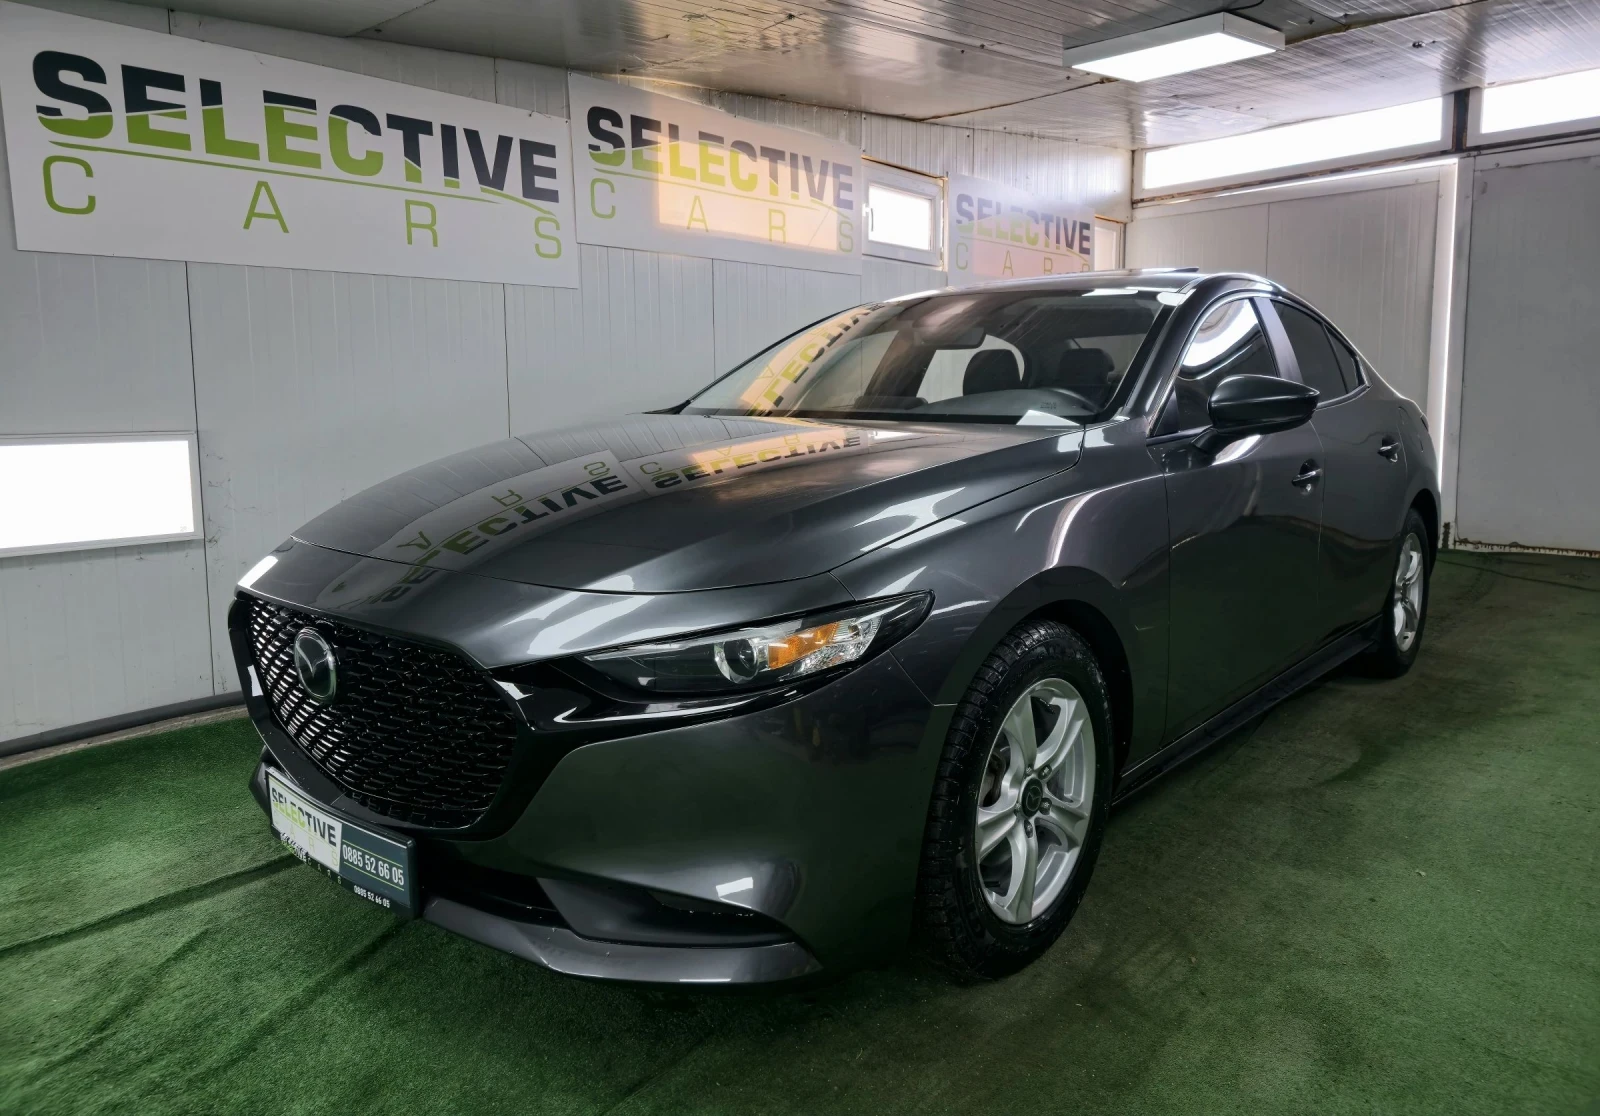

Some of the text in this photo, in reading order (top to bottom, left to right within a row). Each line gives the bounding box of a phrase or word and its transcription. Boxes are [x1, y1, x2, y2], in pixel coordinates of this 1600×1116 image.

[32, 50, 559, 203] SELECTIVE
[586, 106, 854, 210] SELECTIVE
[956, 193, 1091, 256] SELECTIVE
[272, 787, 337, 847] SELECTIVE
[342, 844, 404, 885] 0885 52 66 05
[353, 885, 390, 908] 0885 52 66 05
